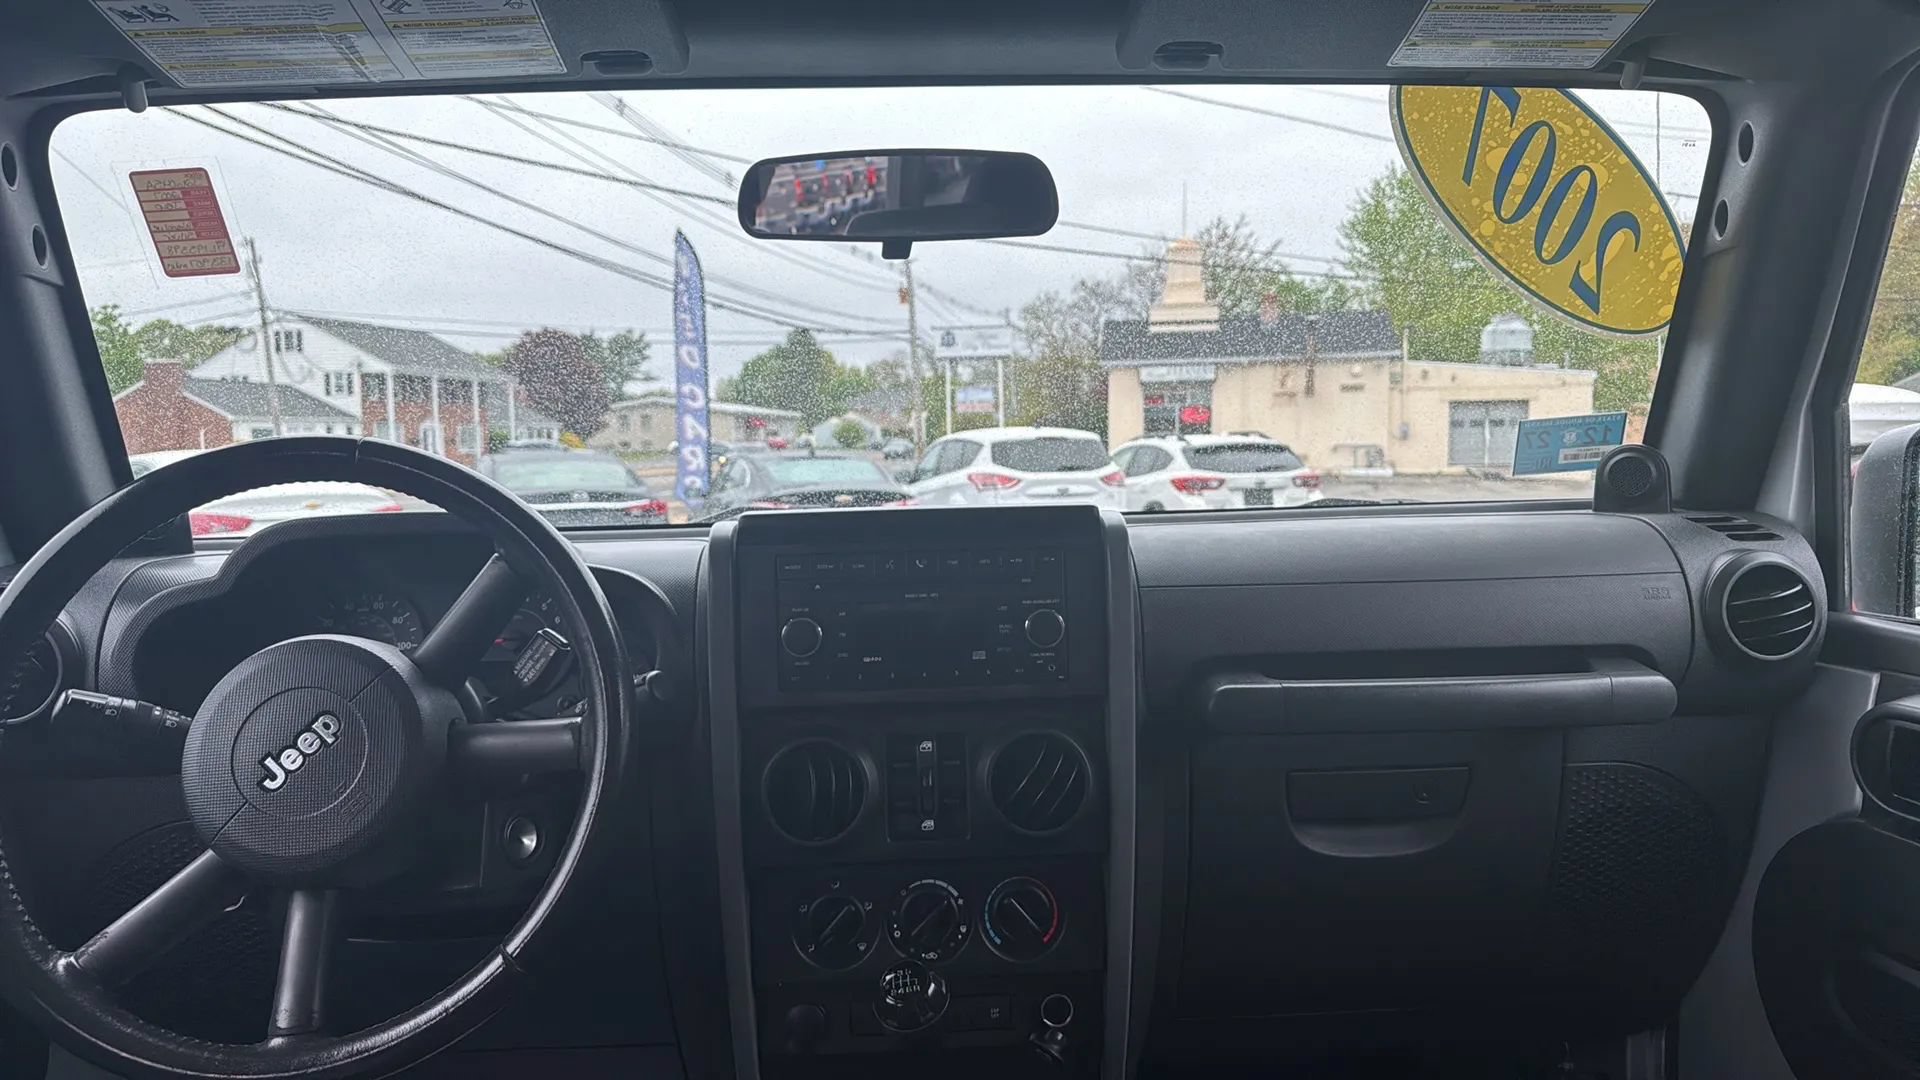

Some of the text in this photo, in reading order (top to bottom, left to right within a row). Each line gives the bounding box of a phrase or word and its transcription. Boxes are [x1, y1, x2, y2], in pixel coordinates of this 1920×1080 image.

[392, 616, 403, 625] 80
[397, 641, 412, 651] 100
[262, 715, 341, 790] Jeep
